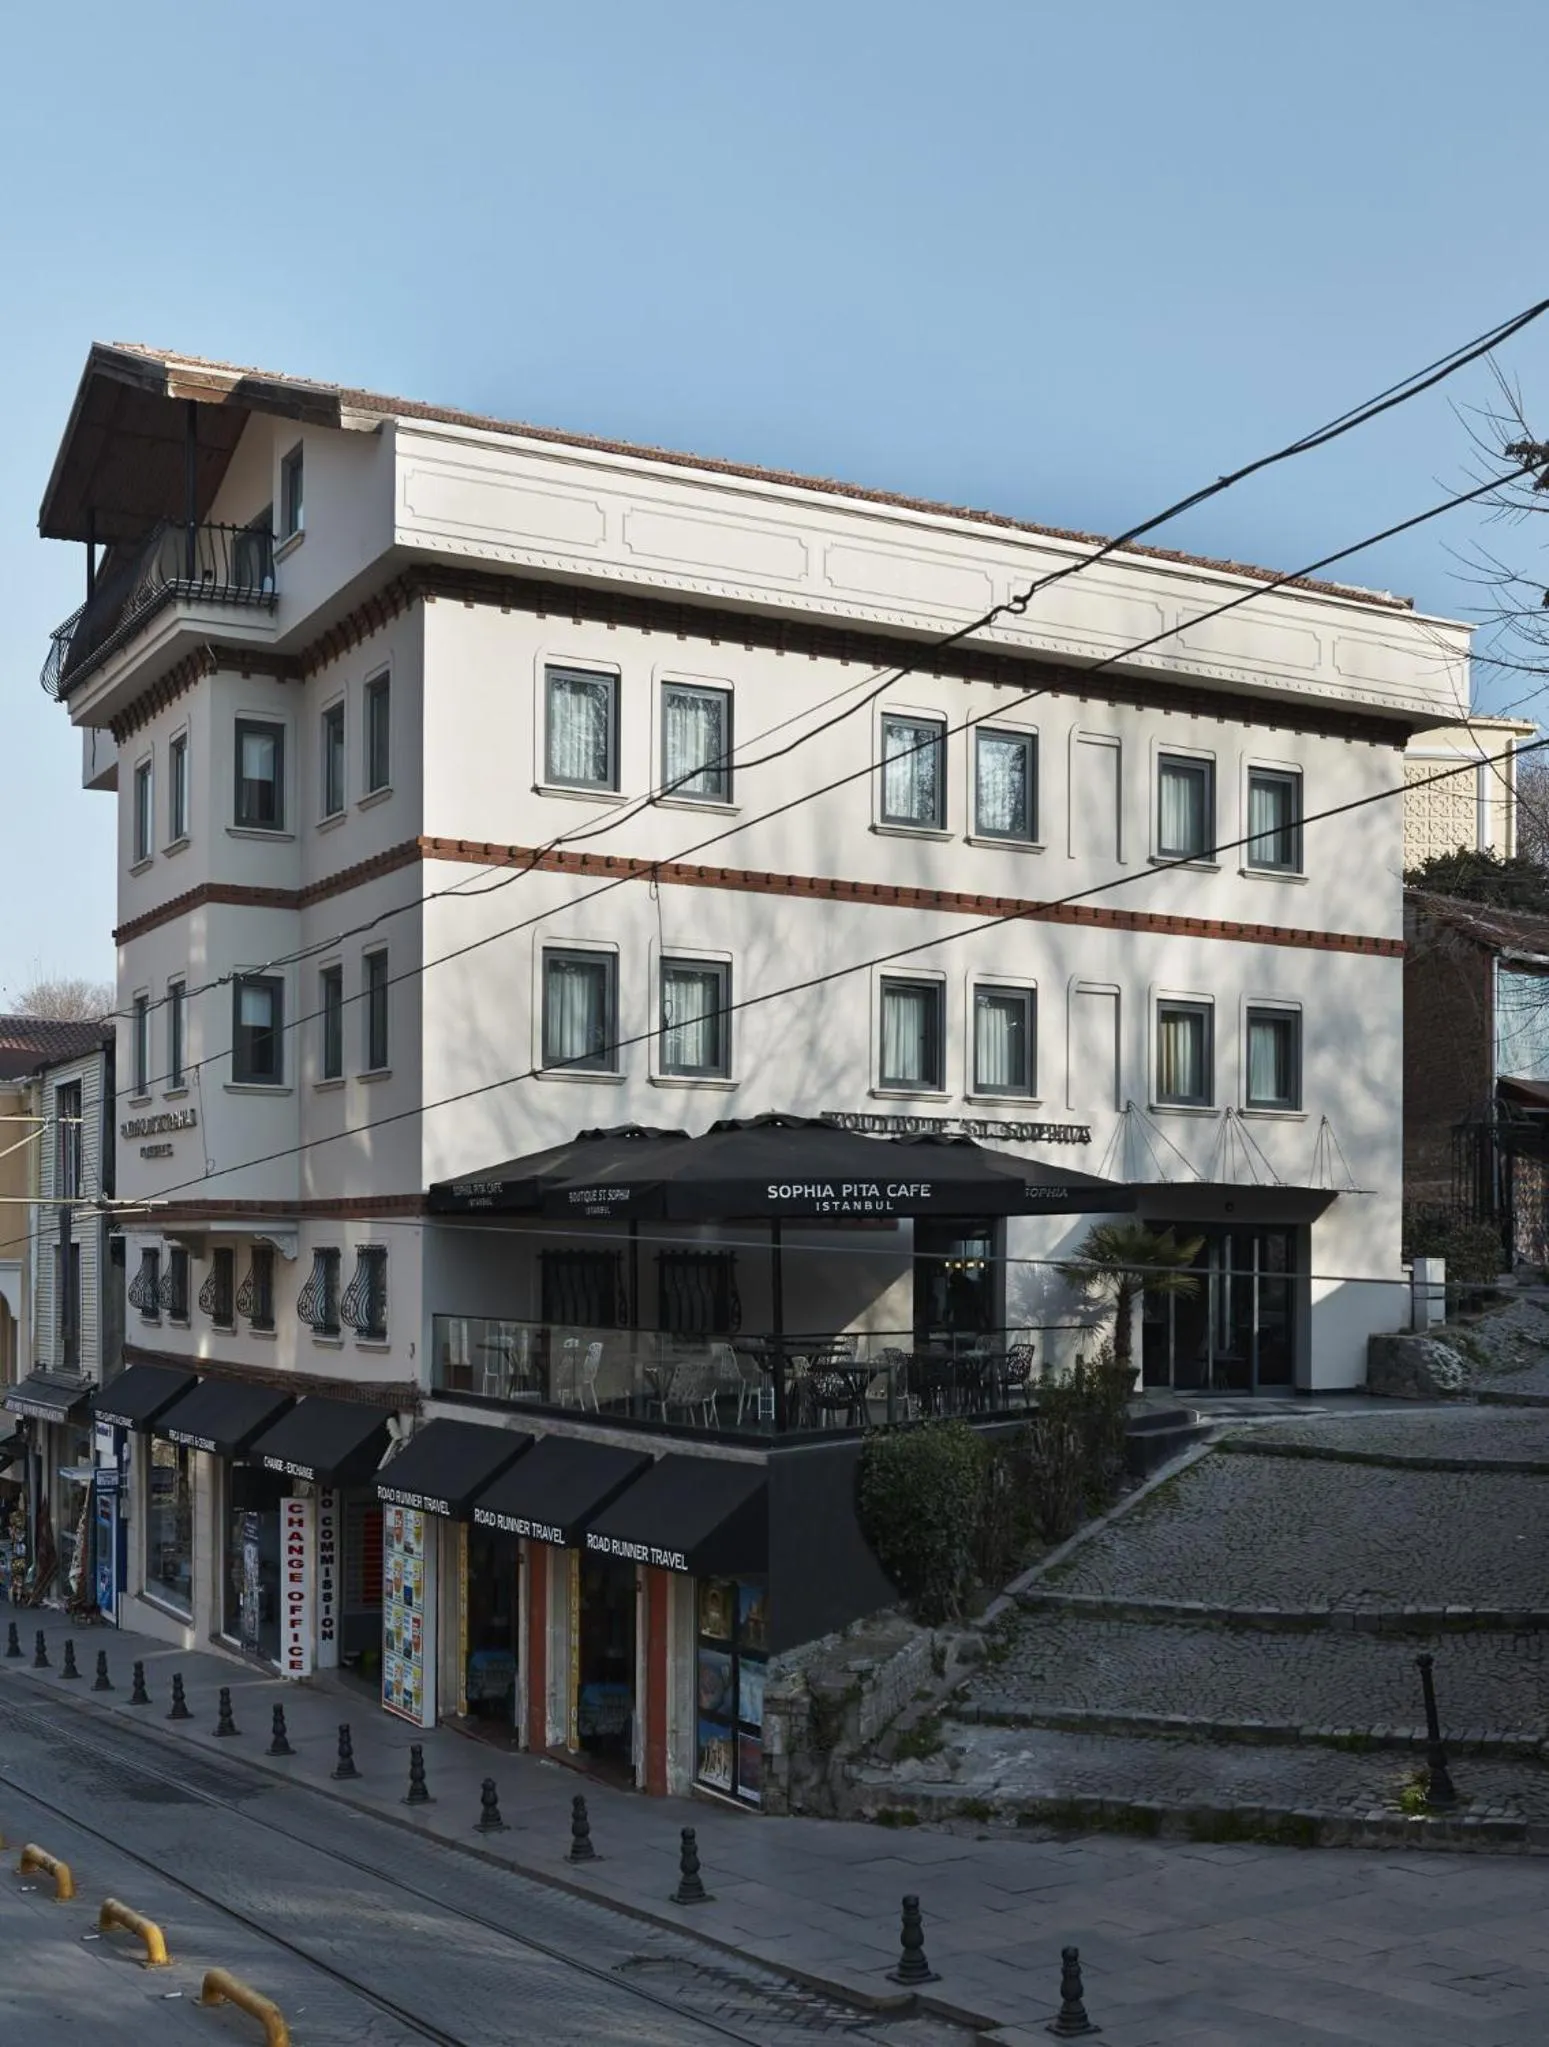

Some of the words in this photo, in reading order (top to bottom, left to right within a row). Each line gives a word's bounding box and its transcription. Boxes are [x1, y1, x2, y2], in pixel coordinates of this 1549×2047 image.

[568, 1190, 597, 1203] BOUTIQUE
[767, 1184, 835, 1199] SOPHIA
[842, 1183, 880, 1198] PITA
[887, 1183, 931, 1198] CAFE
[816, 1201, 894, 1212] ISTANBUL
[264, 1455, 284, 1472] CHANGE
[287, 1461, 315, 1481] EXCHANGE
[377, 1485, 395, 1502] ROAD
[395, 1489, 423, 1509] RUNNER
[423, 1496, 451, 1516] TRAVEL
[287, 1503, 304, 1583] CHANGE
[474, 1507, 496, 1526] ROAD
[497, 1513, 531, 1536] RUNNER
[532, 1522, 566, 1545] TRAVEL
[586, 1532, 610, 1552] ROAD
[611, 1538, 649, 1562] RUNNER
[650, 1547, 689, 1571] TRAVEL
[319, 1516, 335, 1641] COMMISSION
[287, 1591, 304, 1670] OFFICE
